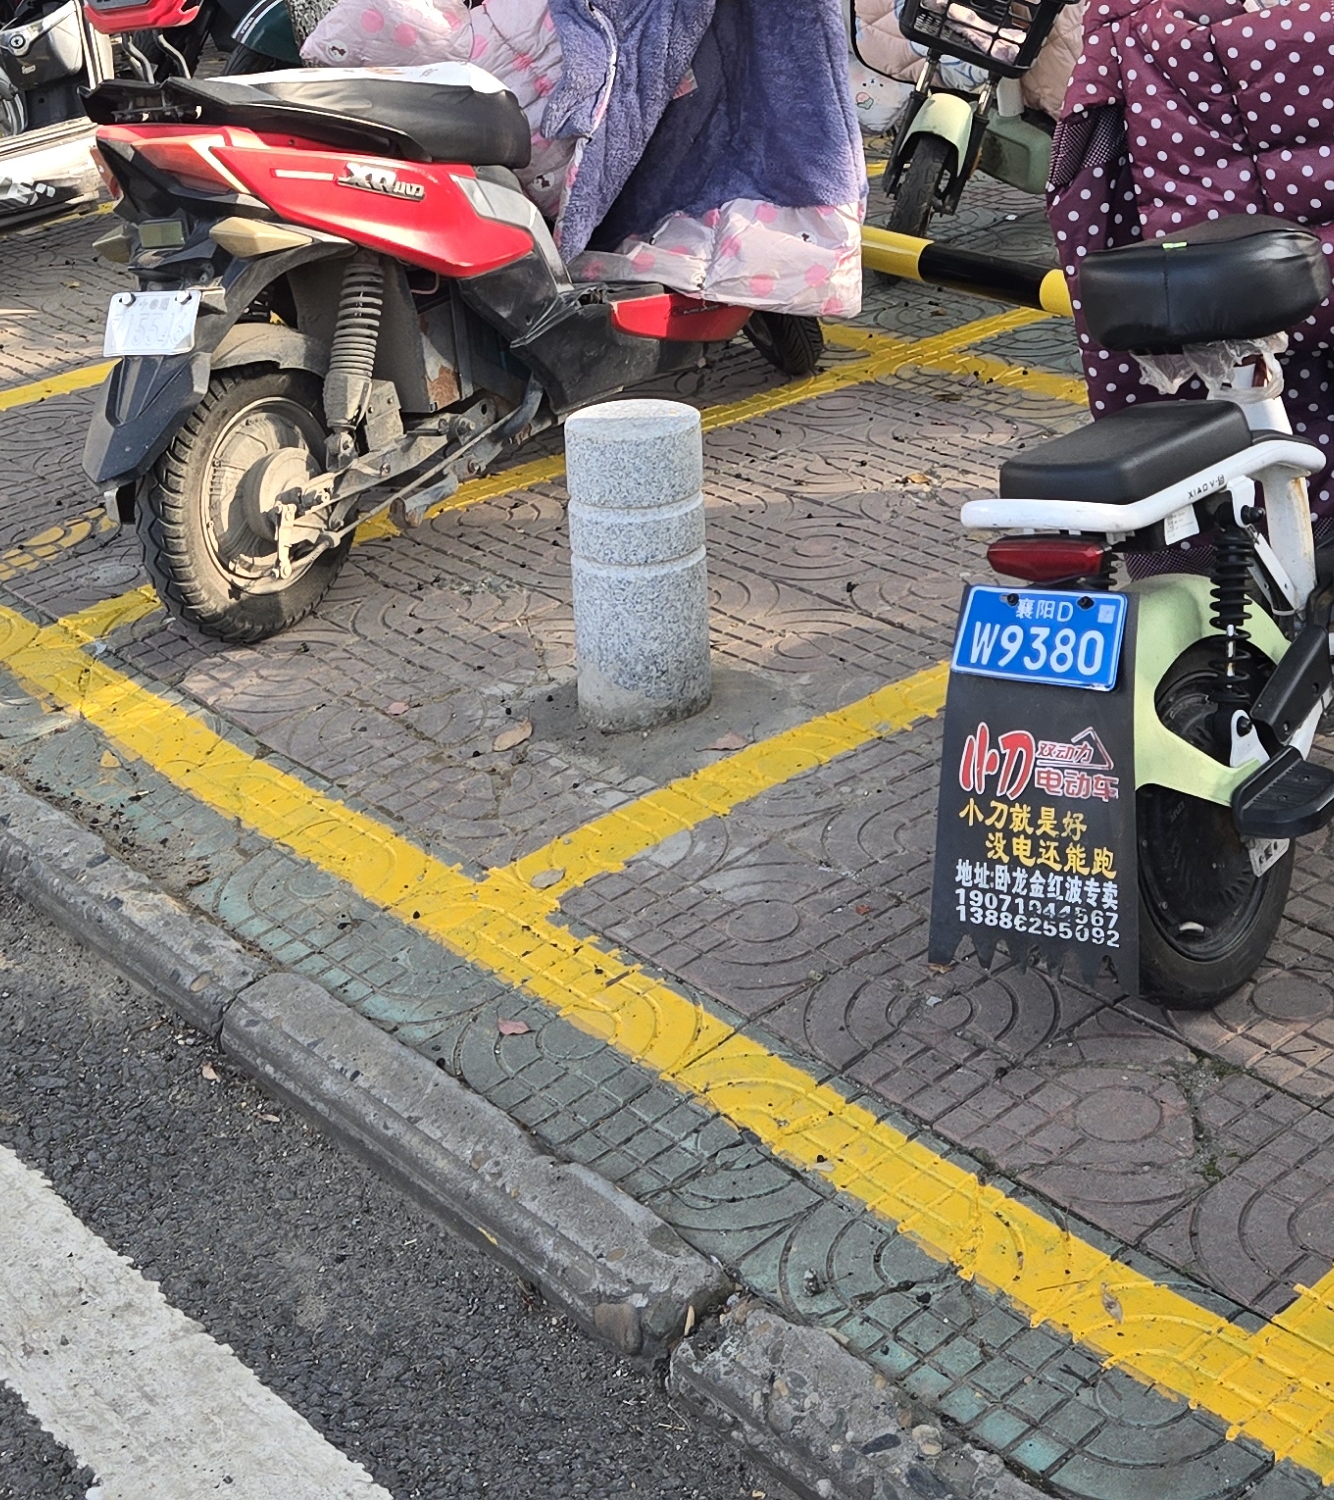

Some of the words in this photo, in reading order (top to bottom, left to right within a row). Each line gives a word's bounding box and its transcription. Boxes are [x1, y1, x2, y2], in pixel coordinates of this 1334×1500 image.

[1014, 596, 1074, 622] 襄阳D
[969, 620, 1105, 676] W9380
[1036, 741, 1094, 765] 双动力
[1033, 768, 1120, 803] 电动车
[958, 798, 1088, 842] 小刀就是好
[985, 833, 1118, 880] 没电还能跑
